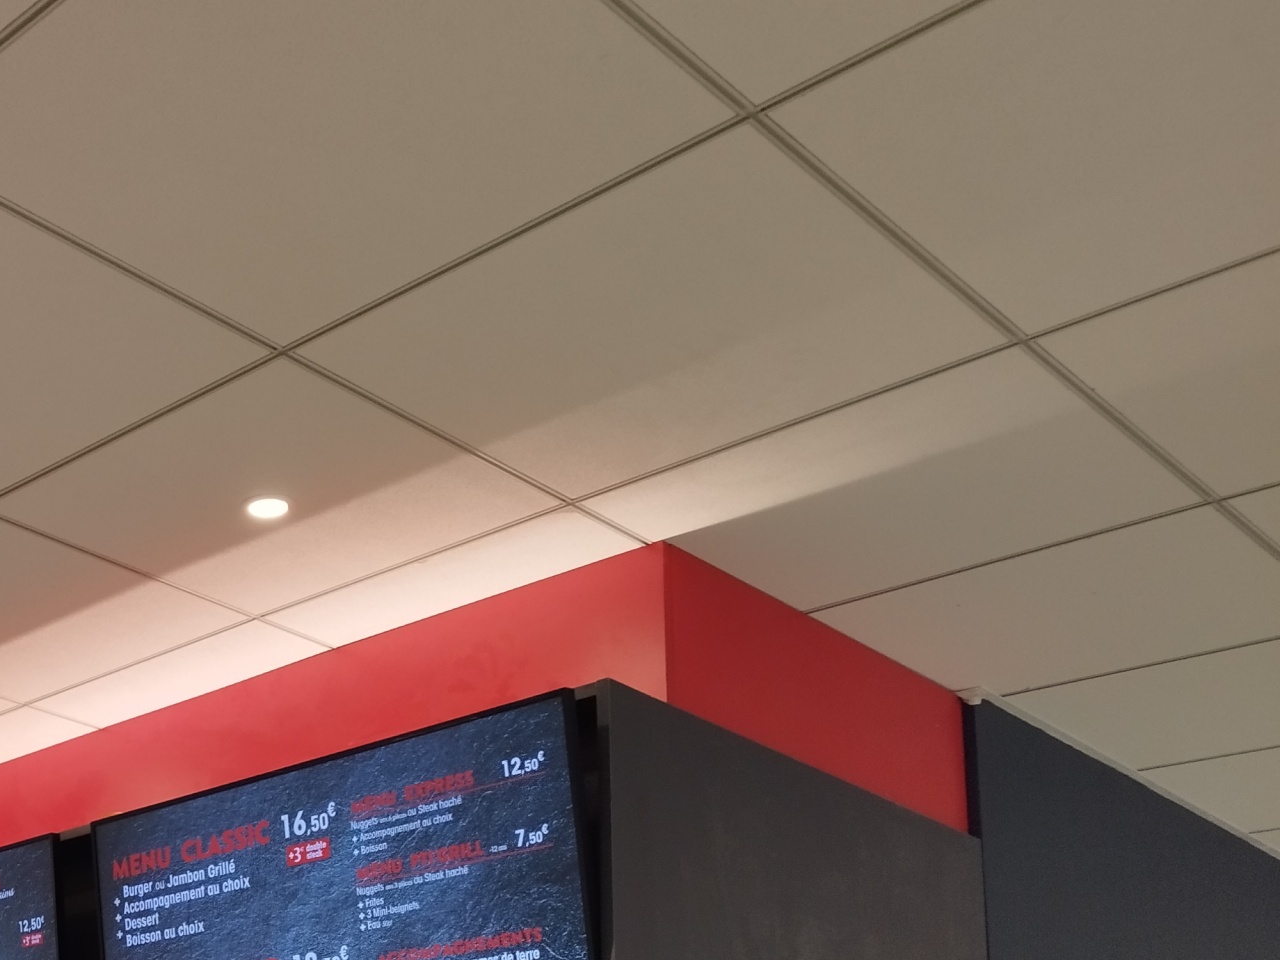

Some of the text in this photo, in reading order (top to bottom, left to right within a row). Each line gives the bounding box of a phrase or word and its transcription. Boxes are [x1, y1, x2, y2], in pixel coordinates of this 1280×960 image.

[422, 818, 432, 826] au
[112, 820, 270, 880] MENU CLASSIC
[122, 858, 236, 898] Burger ou Jambon Grillé
[123, 876, 251, 916] Accompagnement au choix
[124, 912, 160, 931] Dessert
[126, 920, 206, 947] Boisson au choix
